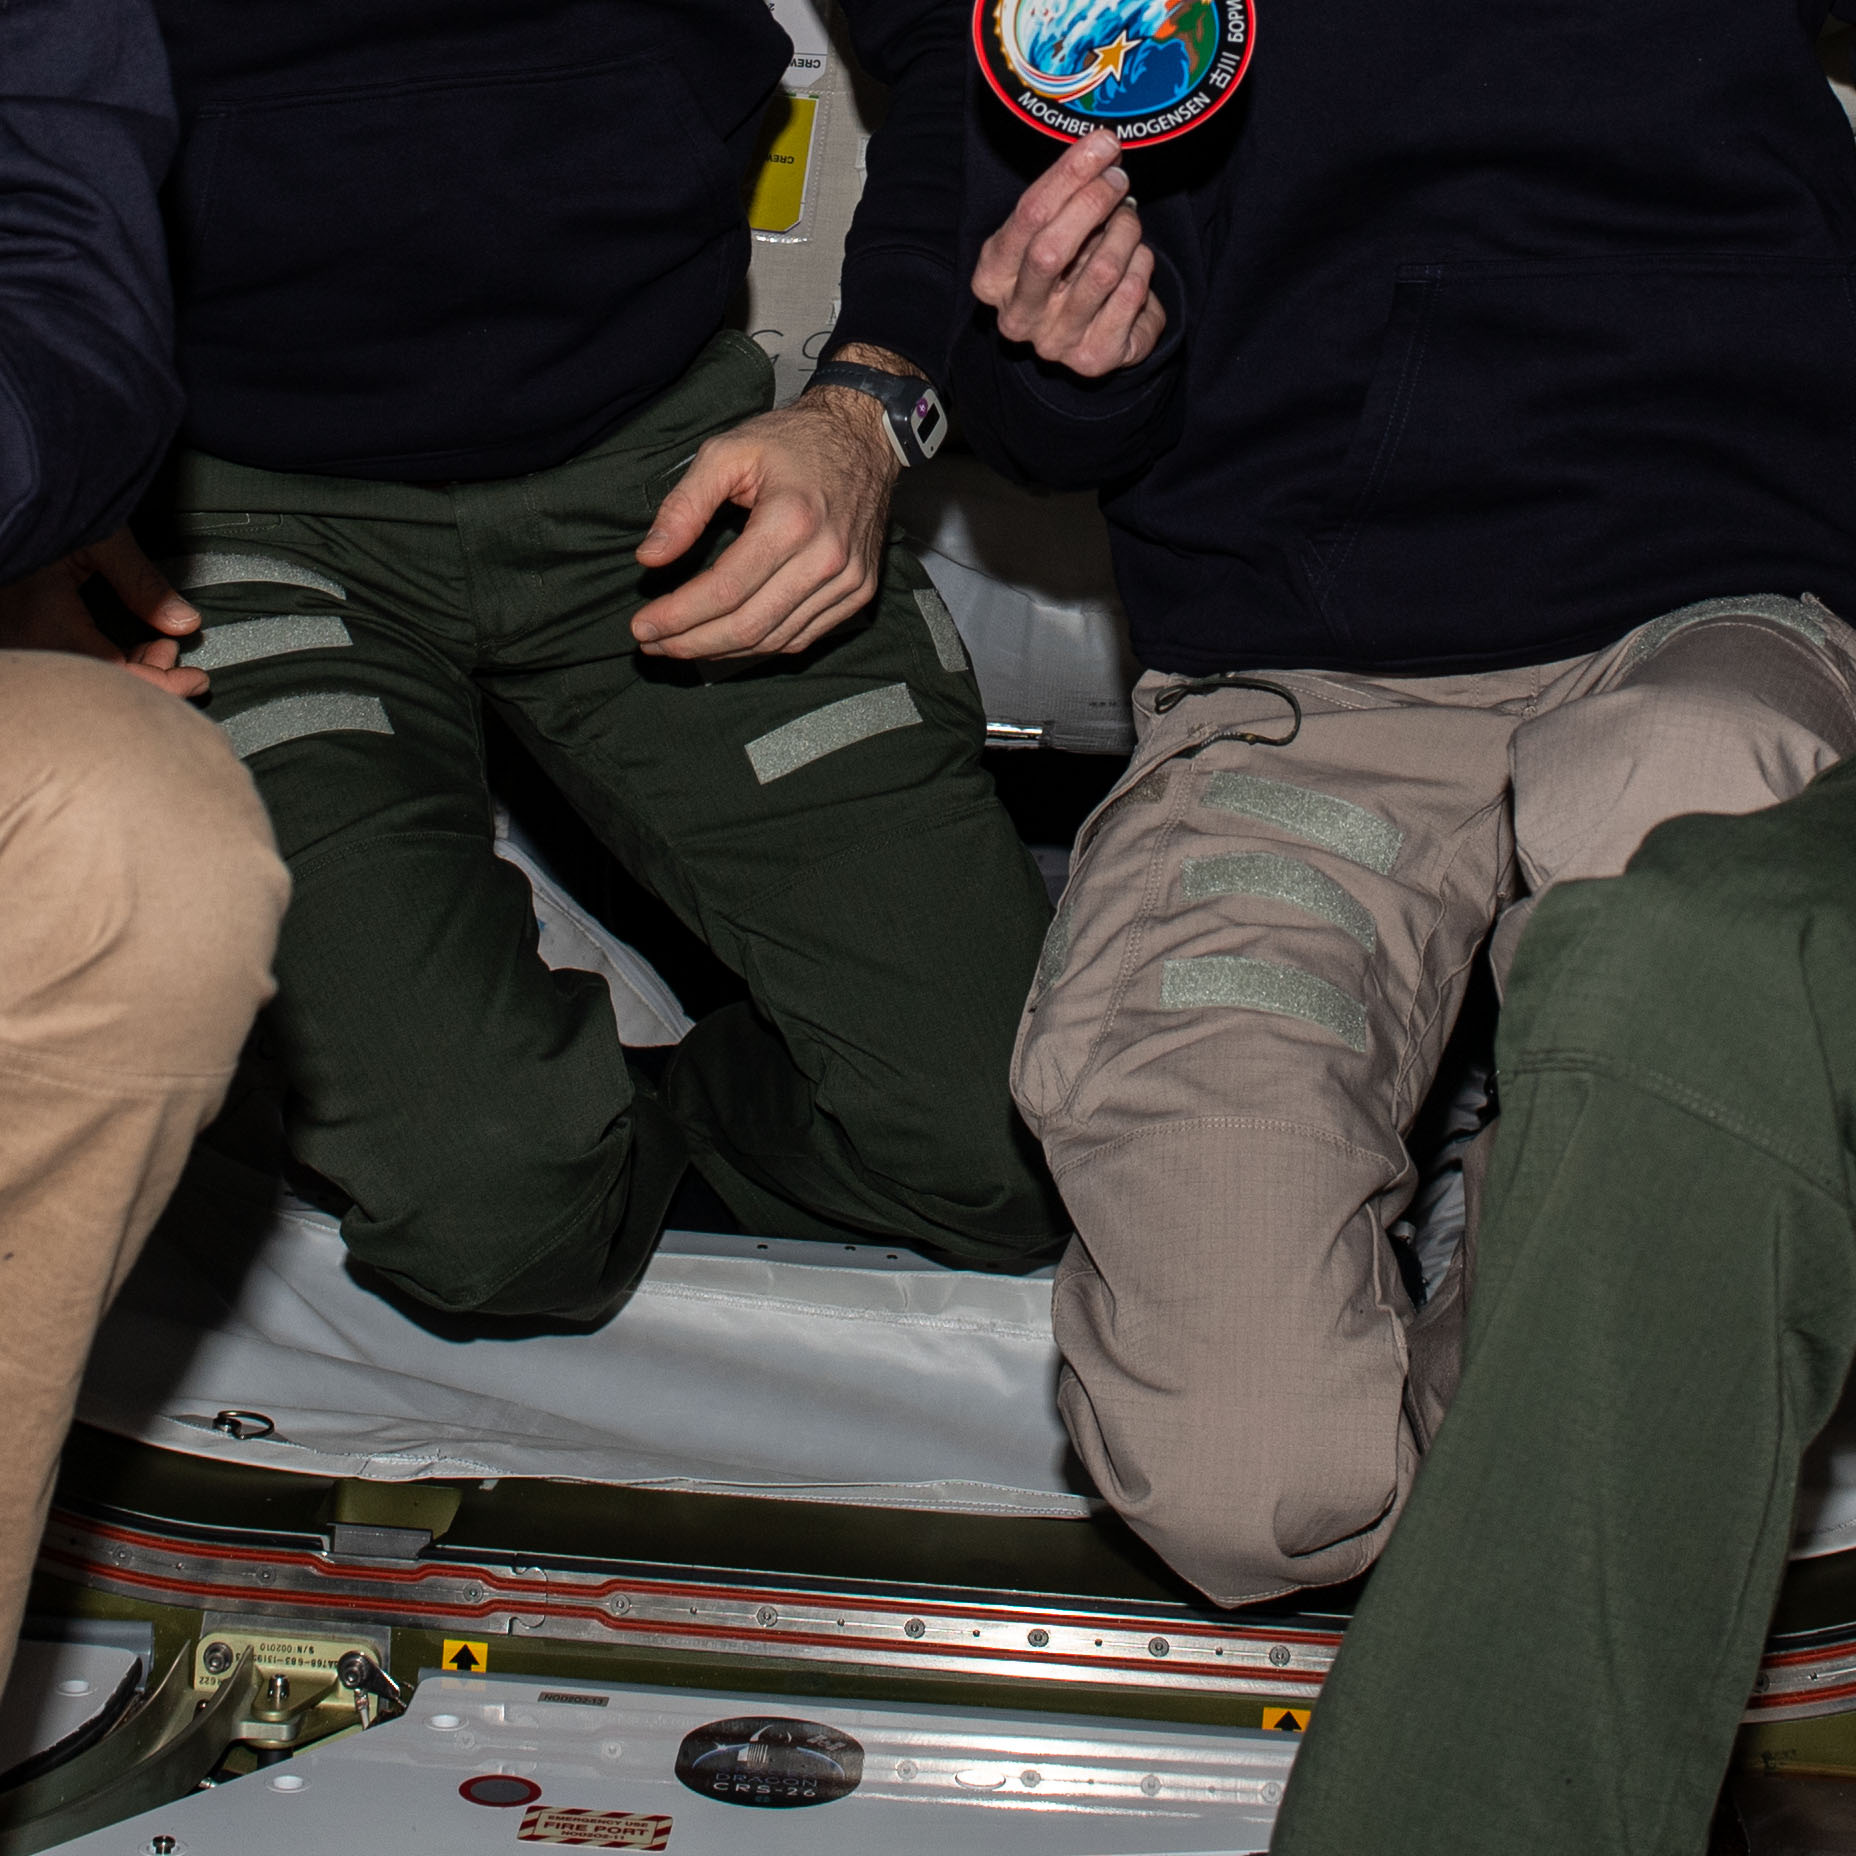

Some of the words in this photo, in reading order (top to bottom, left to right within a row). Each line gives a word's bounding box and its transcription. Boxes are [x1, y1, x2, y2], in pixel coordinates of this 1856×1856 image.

[1207, 50, 1242, 90] 古川
[1017, 91, 1106, 137] MOGHBE
[1116, 91, 1211, 140] MOGENSEN
[715, 1772, 818, 1787] DRAGON
[713, 1782, 816, 1797] CRS-26
[547, 1814, 623, 1826] EMERGENCY
[624, 1820, 649, 1828] USE
[543, 1821, 591, 1832] FIRE
[593, 1824, 650, 1837] PORT
